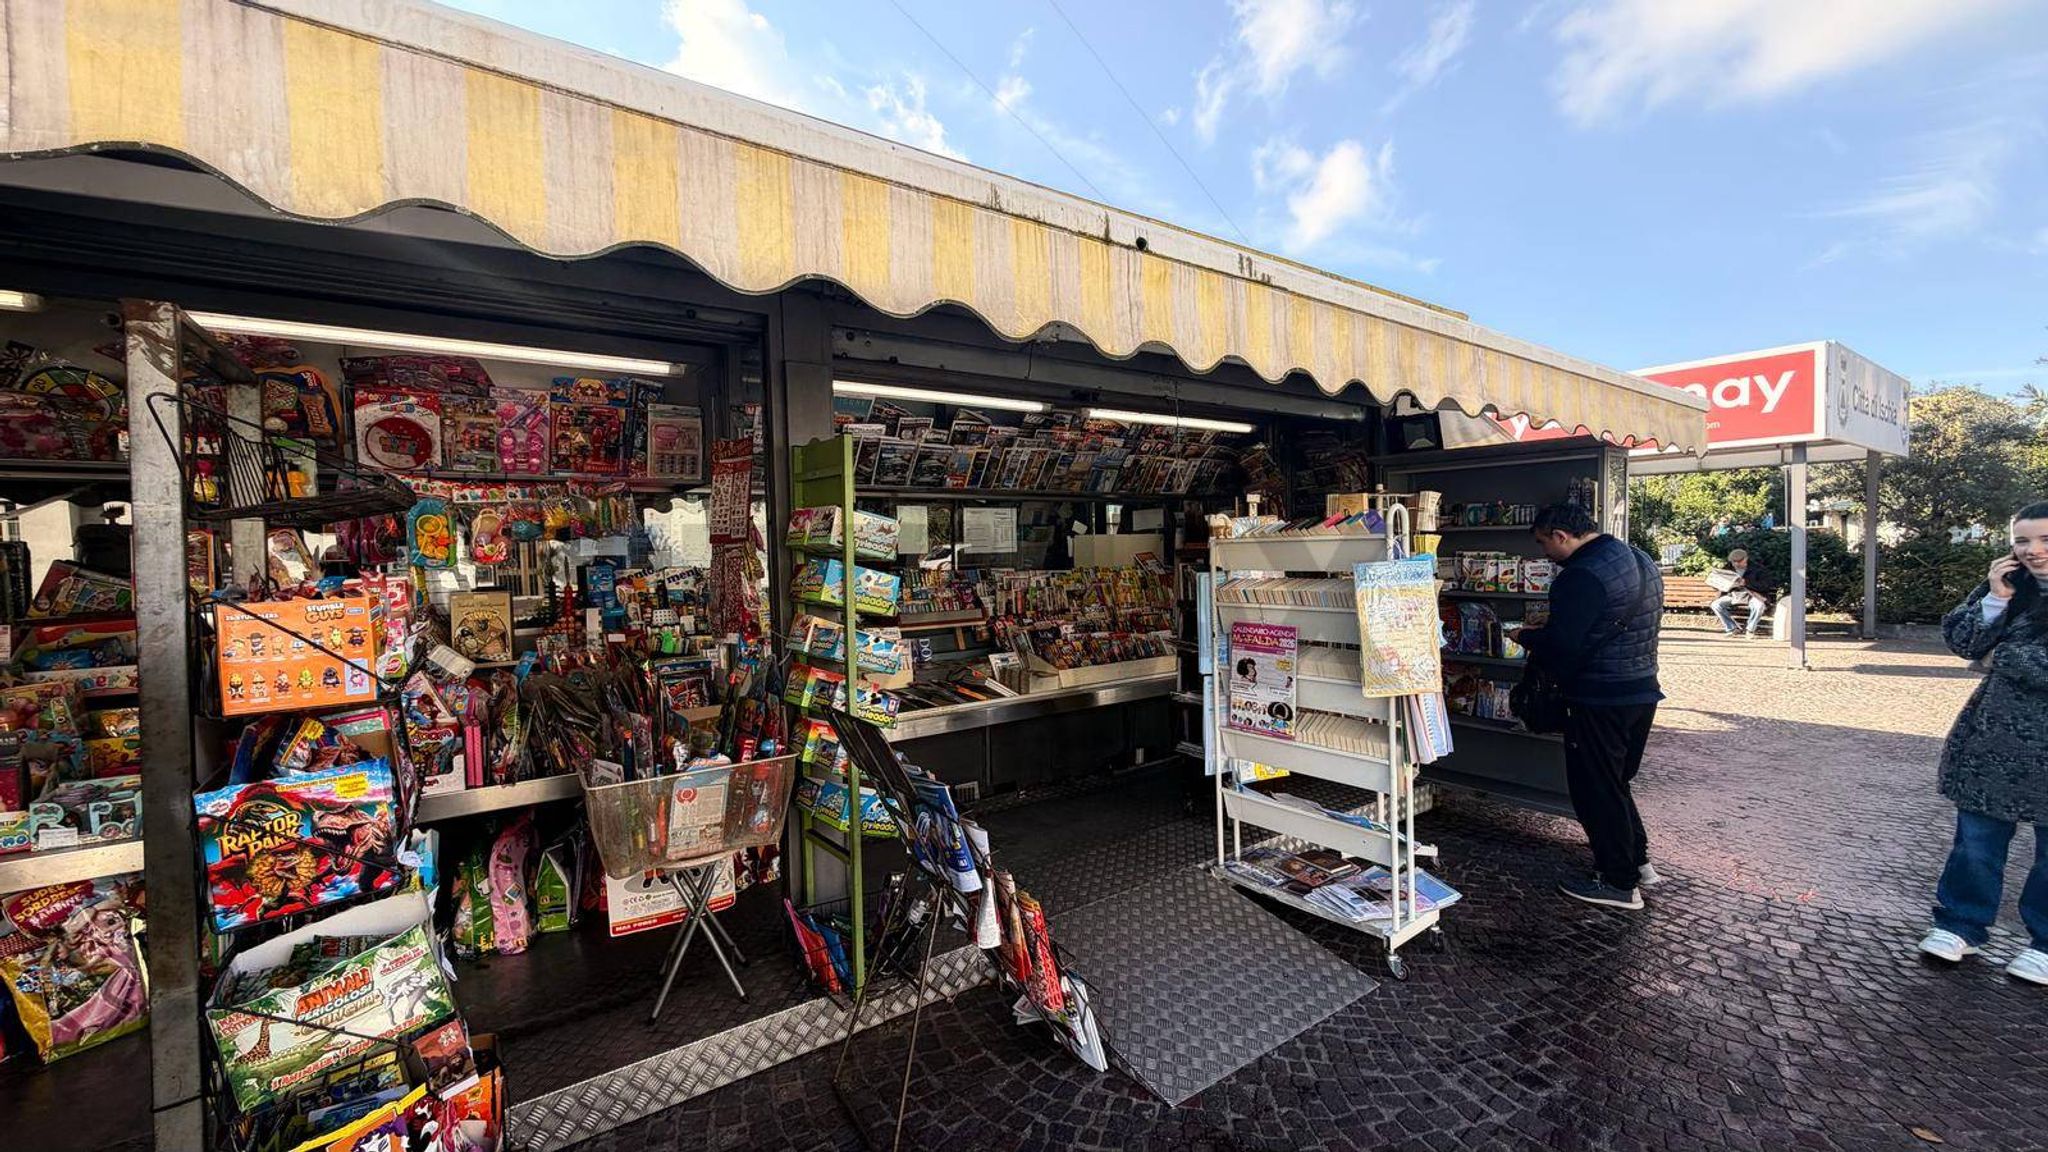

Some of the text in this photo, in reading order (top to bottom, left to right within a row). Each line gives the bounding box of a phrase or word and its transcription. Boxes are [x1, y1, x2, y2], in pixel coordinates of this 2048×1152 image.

[305, 608, 344, 624] GUYS
[20, 883, 68, 907] SUPER
[296, 966, 371, 1017] ANIMALI
[297, 984, 373, 1023] PERICOLOSI
